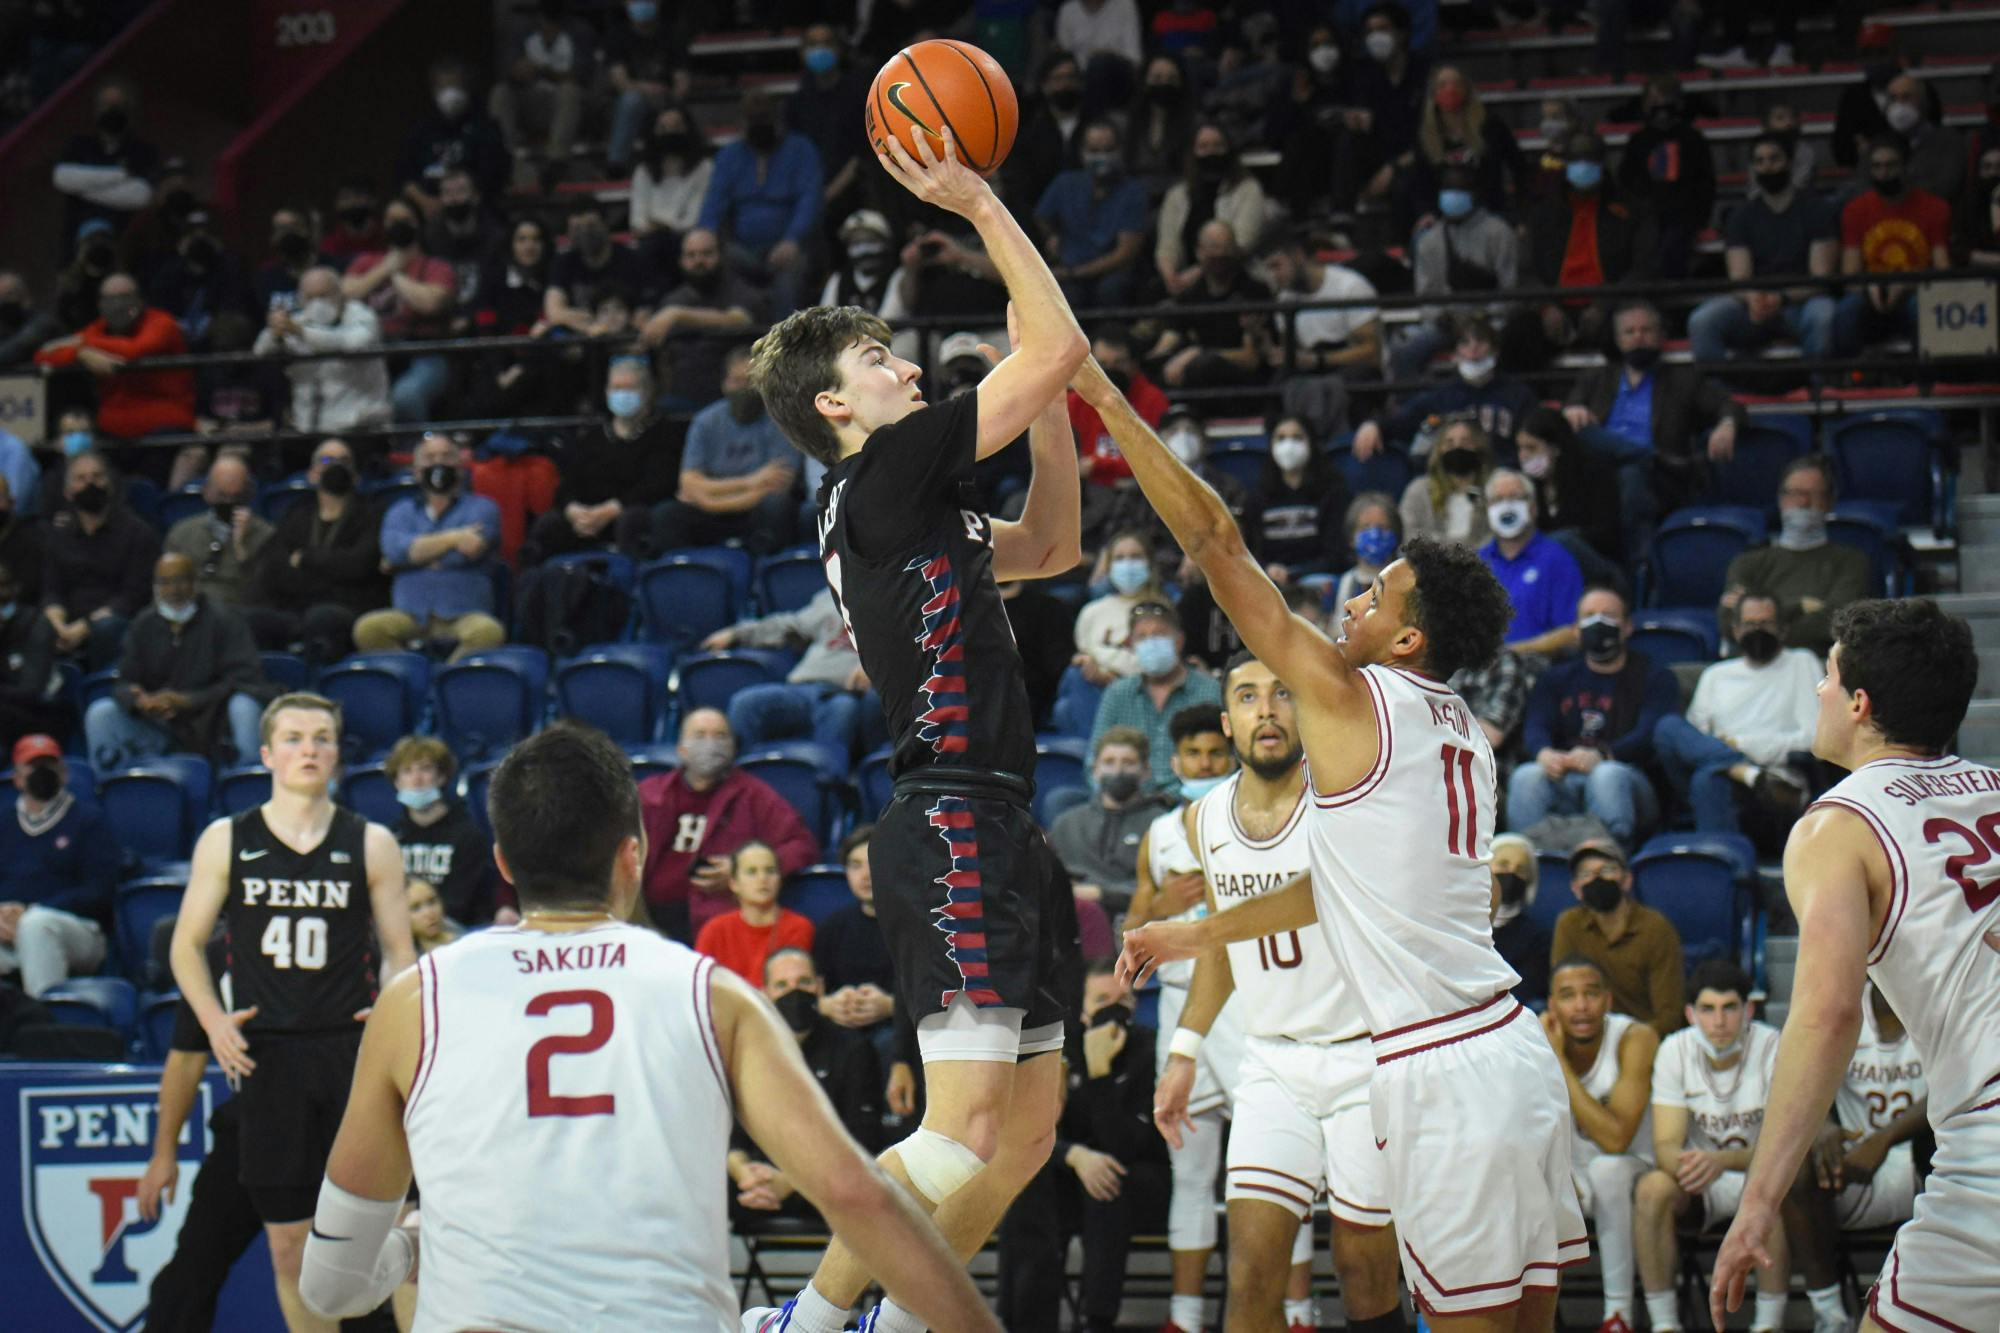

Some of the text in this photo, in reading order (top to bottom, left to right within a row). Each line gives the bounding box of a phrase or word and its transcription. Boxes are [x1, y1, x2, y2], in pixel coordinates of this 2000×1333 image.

[1932, 301, 1987, 330] 104
[1441, 743, 1478, 860] 11
[673, 812, 708, 854] H
[242, 877, 350, 909] PENN
[1214, 871, 1299, 897] HARVA
[261, 915, 328, 970] 40
[512, 942, 626, 974] SAKOTA
[525, 988, 616, 1118] 2
[89, 1177, 163, 1284] P
